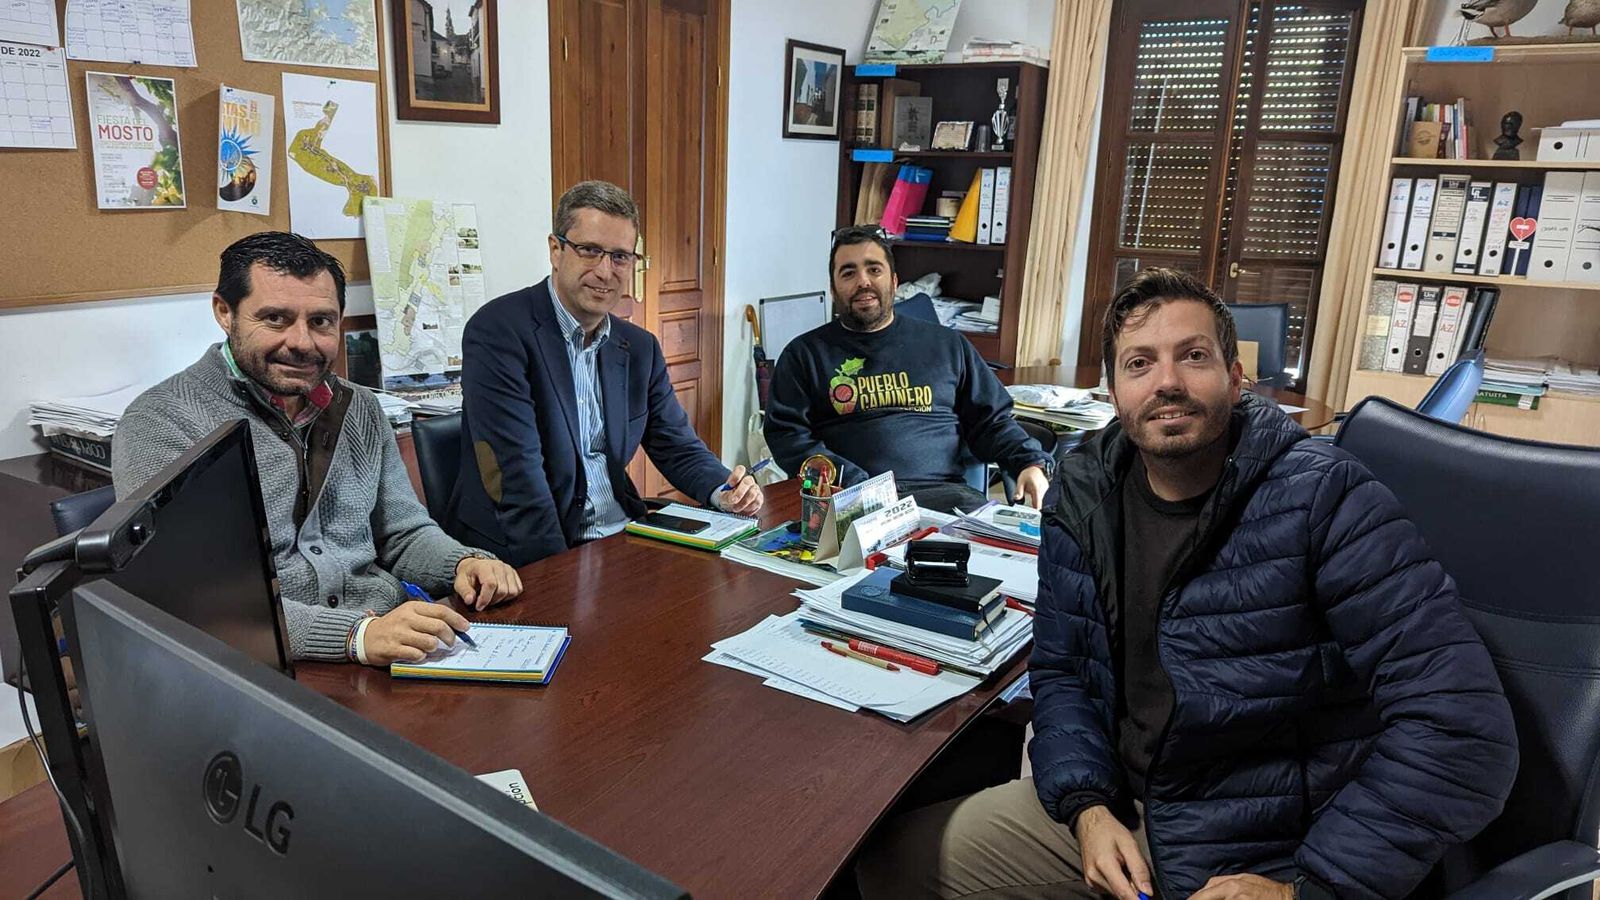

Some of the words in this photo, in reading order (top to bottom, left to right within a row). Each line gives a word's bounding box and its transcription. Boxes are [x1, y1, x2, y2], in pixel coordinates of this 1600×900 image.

[1, 46, 15, 56] DE
[19, 48, 41, 58] 2022
[97, 114, 131, 125] FIESTA
[98, 124, 154, 141] MOSTO
[857, 371, 909, 394] PUEBLO
[860, 385, 933, 411] CAMINERO
[884, 500, 913, 518] 2022
[243, 783, 295, 857] LG
